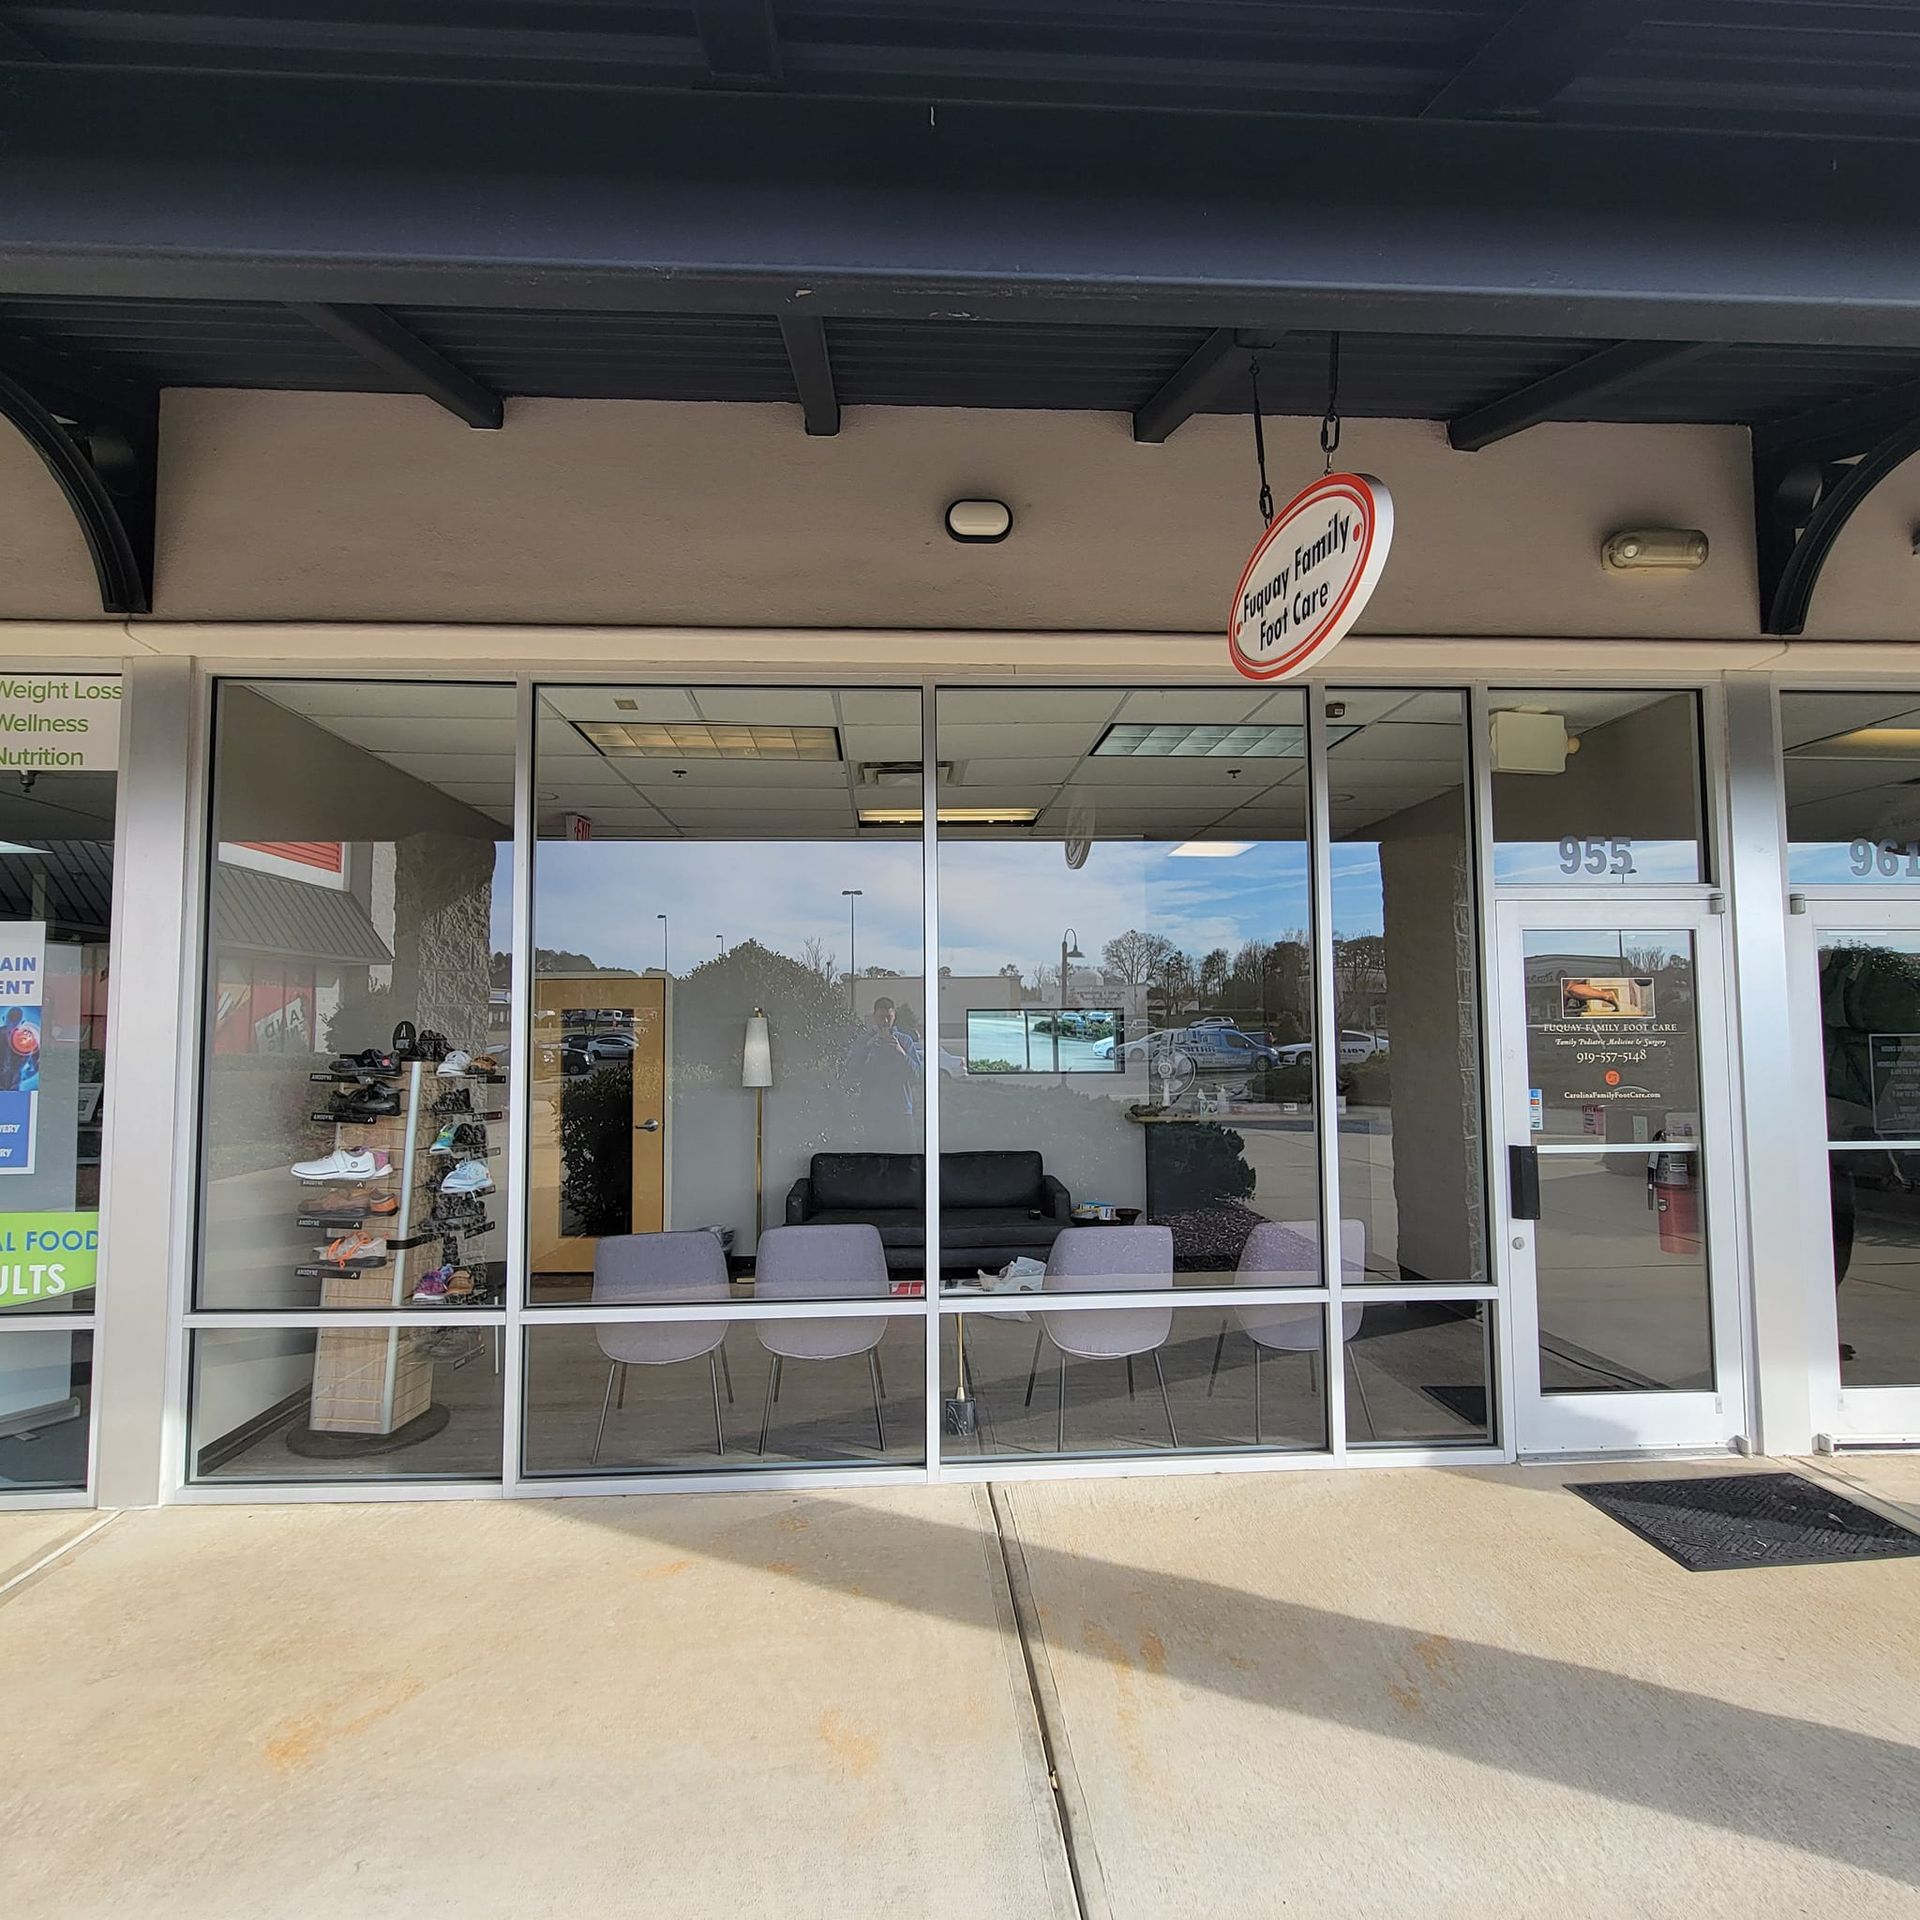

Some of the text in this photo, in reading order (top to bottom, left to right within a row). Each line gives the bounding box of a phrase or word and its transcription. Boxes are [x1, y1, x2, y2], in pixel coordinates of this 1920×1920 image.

[1243, 513, 1350, 623] Fuquay Family
[1260, 582, 1329, 651] Foot Care
[74, 681, 122, 700] Loss
[1559, 836, 1633, 875] 955
[1849, 838, 1920, 877] 961
[1623, 1023, 1649, 1032] FOOT
[1651, 1023, 1678, 1032] CARE
[1576, 1049, 1647, 1063] 919-557-5148
[1564, 1091, 1661, 1101] CarolinaFamilyFootCare.com
[26, 1230, 98, 1251] FOOD
